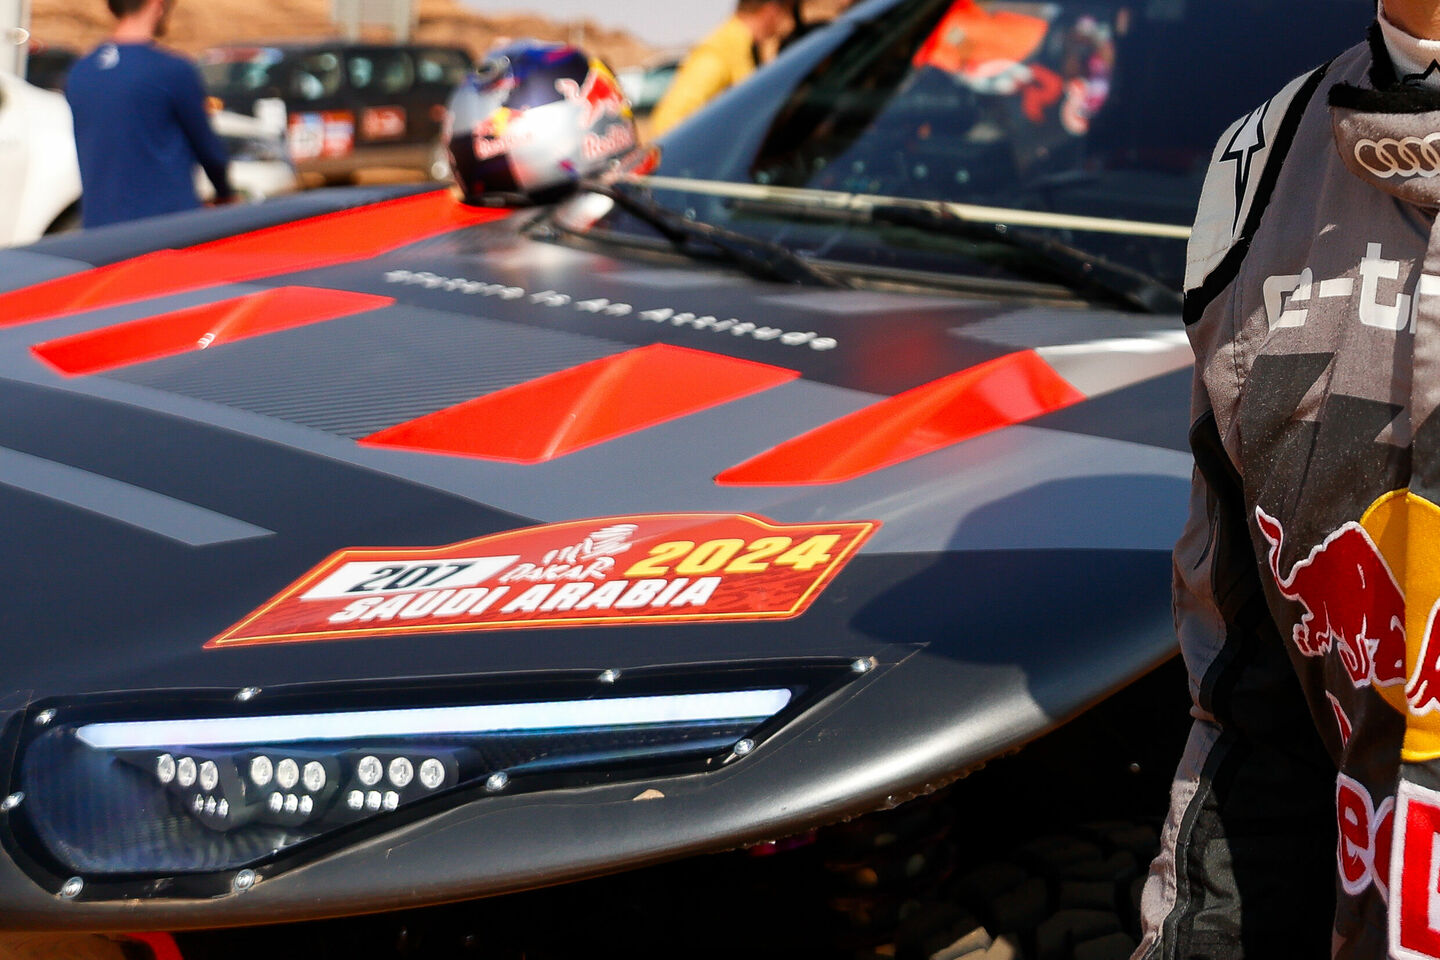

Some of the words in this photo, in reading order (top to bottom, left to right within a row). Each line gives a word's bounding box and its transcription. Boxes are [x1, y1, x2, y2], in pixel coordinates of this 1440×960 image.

[624, 535, 840, 576] 2024
[344, 561, 478, 592] 207
[328, 586, 511, 624] SAUDI
[501, 577, 721, 613] ARABIA
